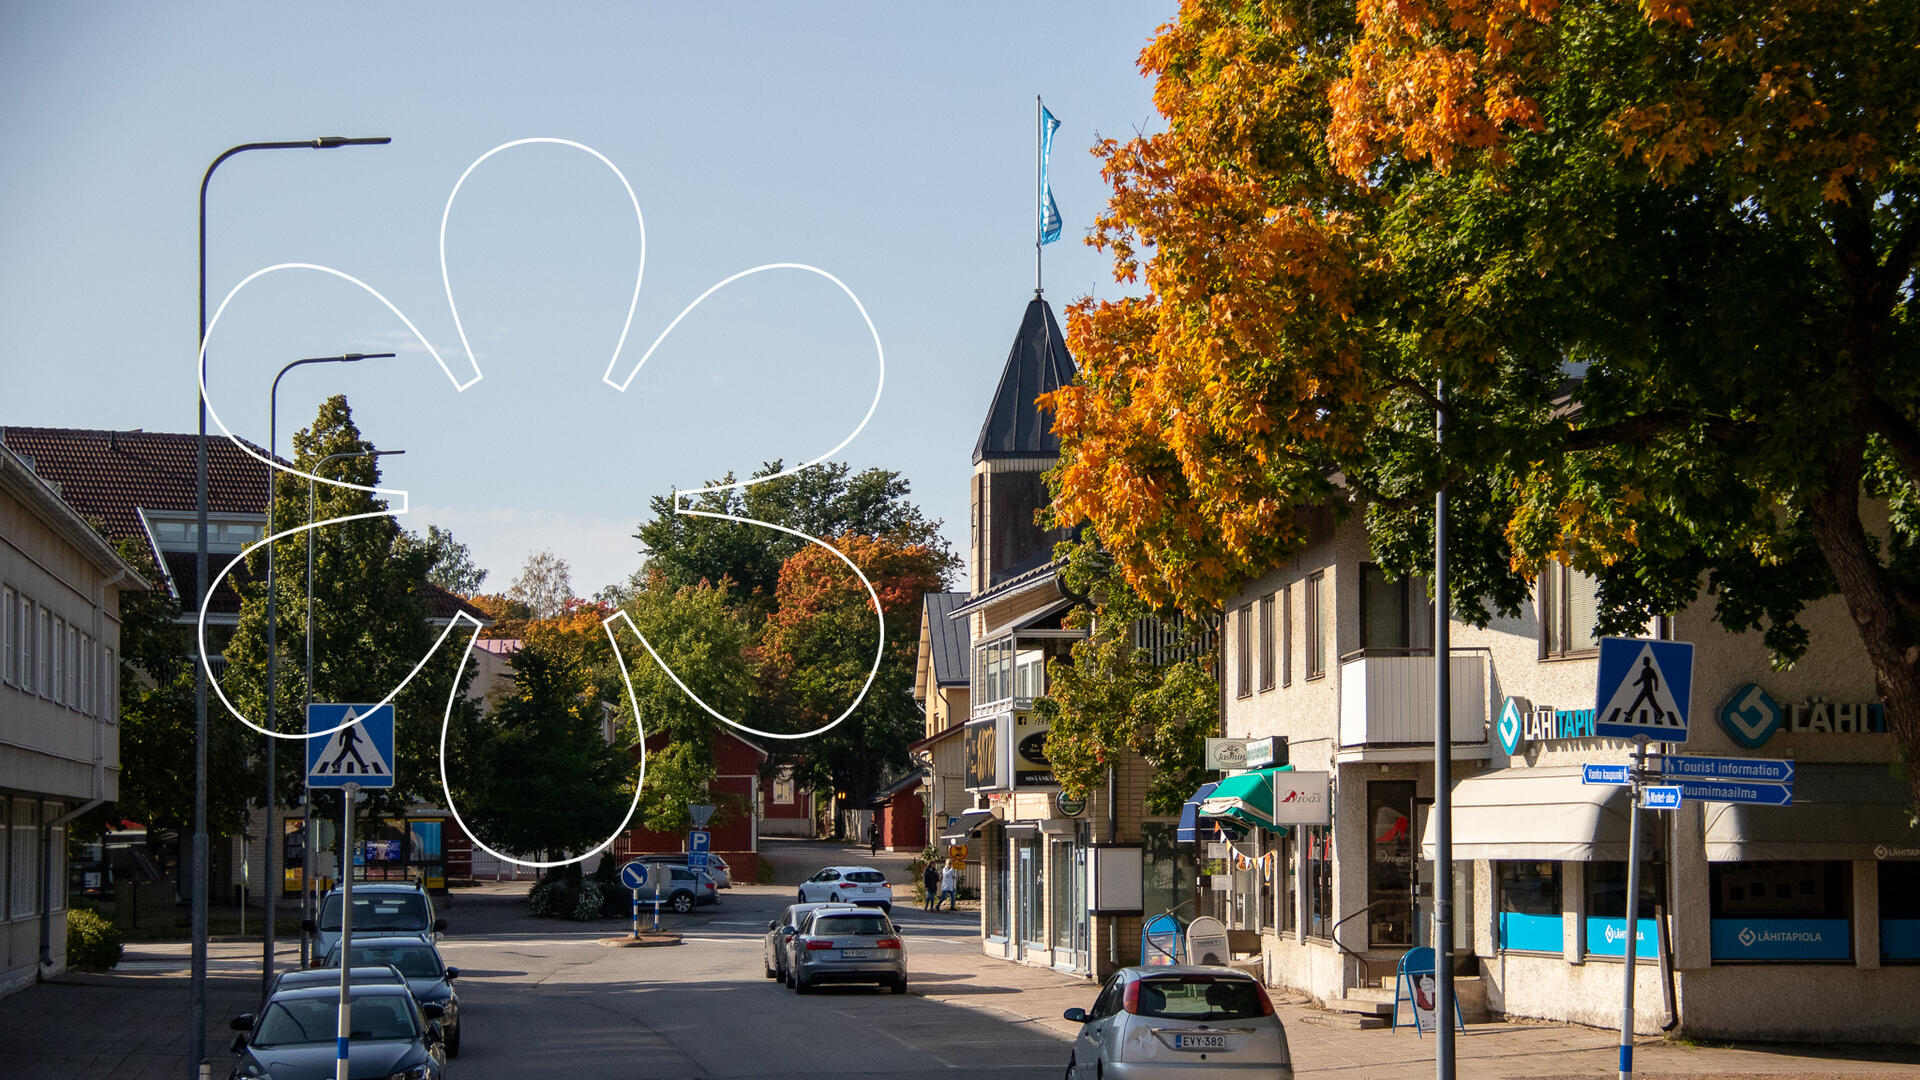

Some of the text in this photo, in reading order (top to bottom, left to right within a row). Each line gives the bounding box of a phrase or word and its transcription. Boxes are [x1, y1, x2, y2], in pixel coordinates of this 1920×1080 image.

[1677, 760, 1780, 777] Tourist information
[693, 833, 707, 850] P
[1758, 931, 1822, 942] LÄHITAPIOLA
[1183, 1036, 1224, 1047] EVY-382
